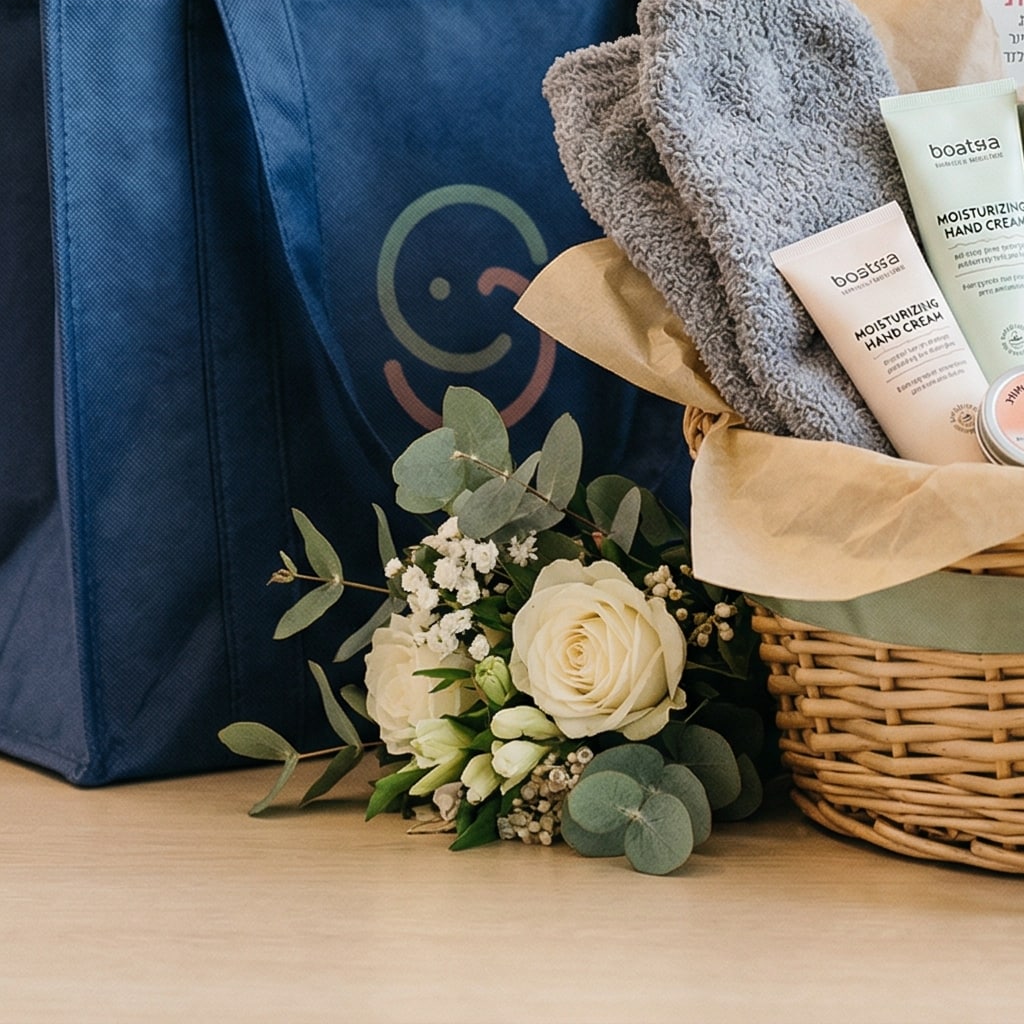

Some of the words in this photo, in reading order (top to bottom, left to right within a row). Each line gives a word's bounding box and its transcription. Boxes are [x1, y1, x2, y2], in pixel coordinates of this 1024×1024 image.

[944, 222, 982, 239] HAND
[854, 298, 940, 342] MOISTURIZING
[864, 327, 902, 351] HAND
[902, 311, 945, 333] CREAM
